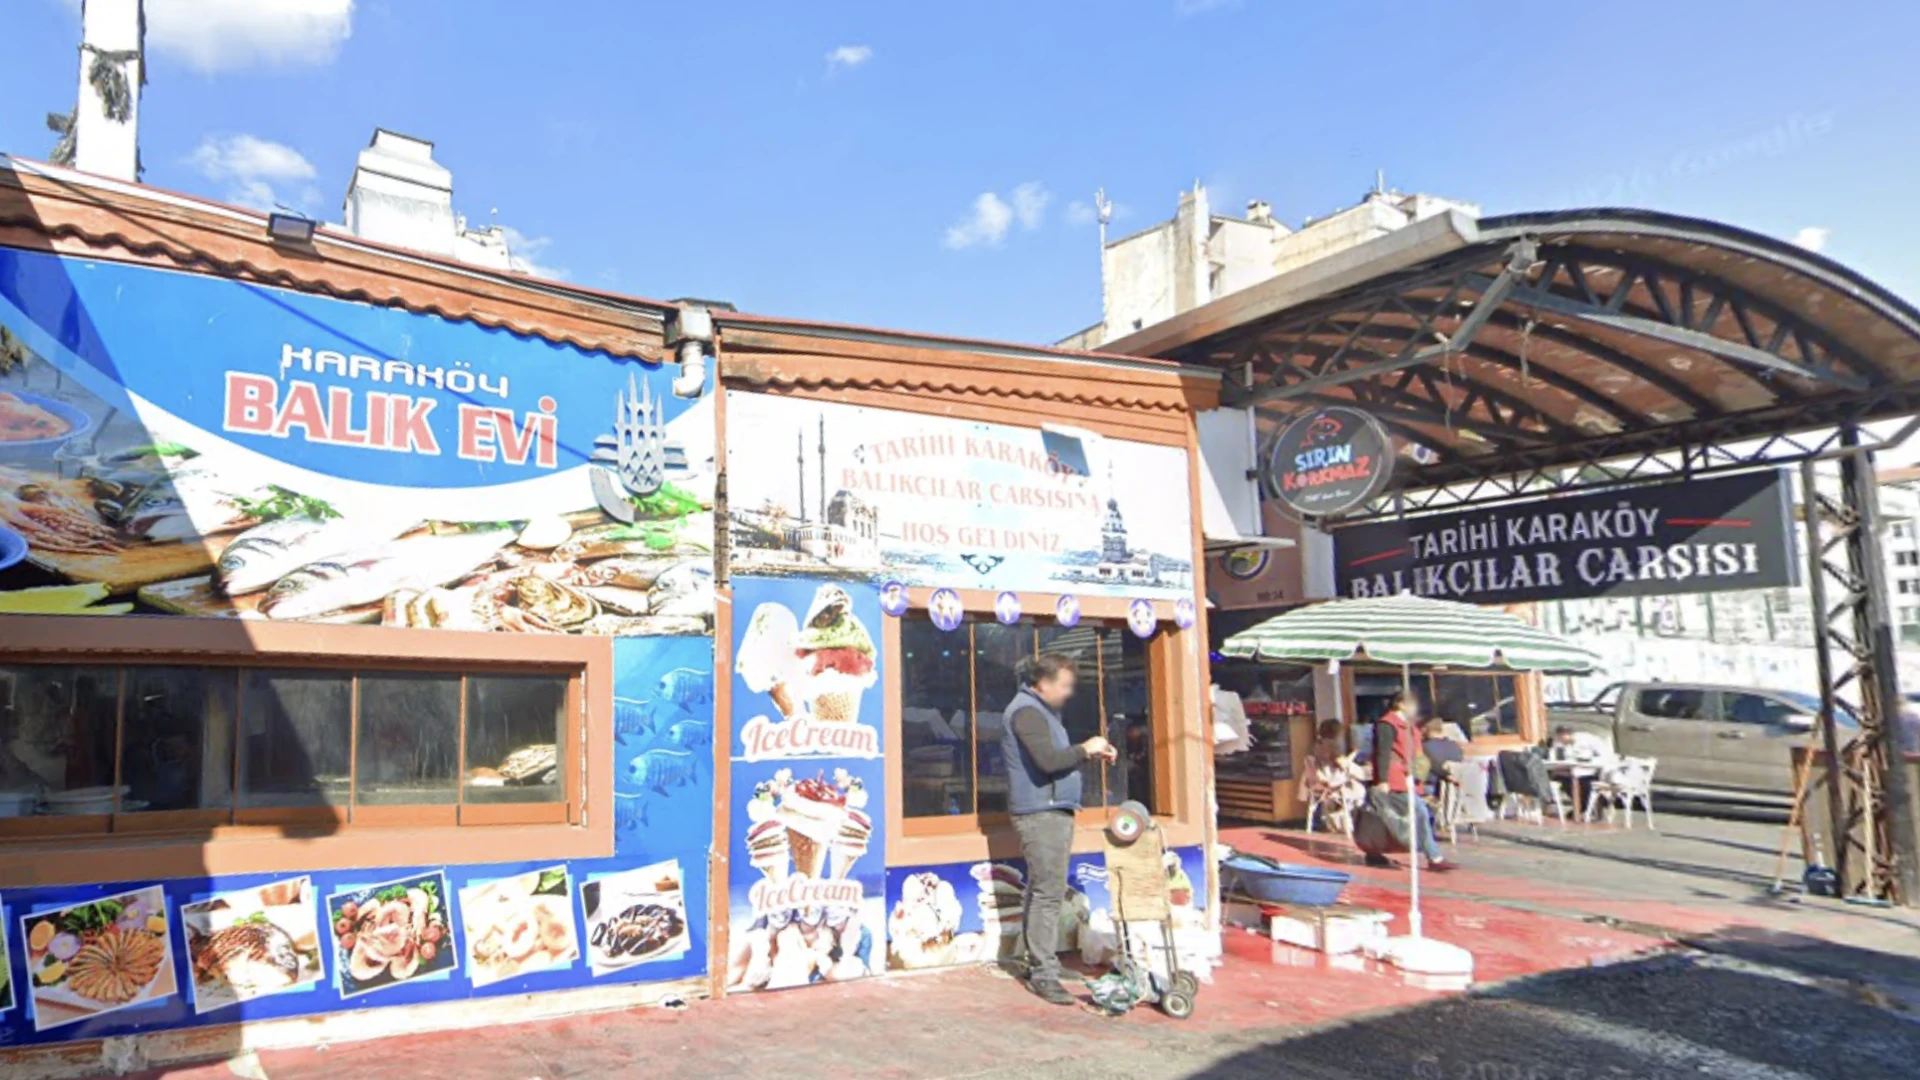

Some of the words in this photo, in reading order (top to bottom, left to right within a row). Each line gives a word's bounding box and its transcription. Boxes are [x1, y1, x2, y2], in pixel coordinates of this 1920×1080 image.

[281, 344, 510, 398] KARAKÖY
[224, 371, 440, 455] BALIK
[458, 395, 559, 468] EVİ
[965, 436, 1077, 484] KARAKÖY
[1408, 514, 1499, 559] TARİHİ
[1507, 501, 1660, 546] KARAKÖY
[1350, 551, 1563, 599] BALIKÇILAR
[1576, 542, 1760, 587] ÇARŞISI
[748, 718, 873, 755] IceCream
[754, 876, 861, 912] IceCream
